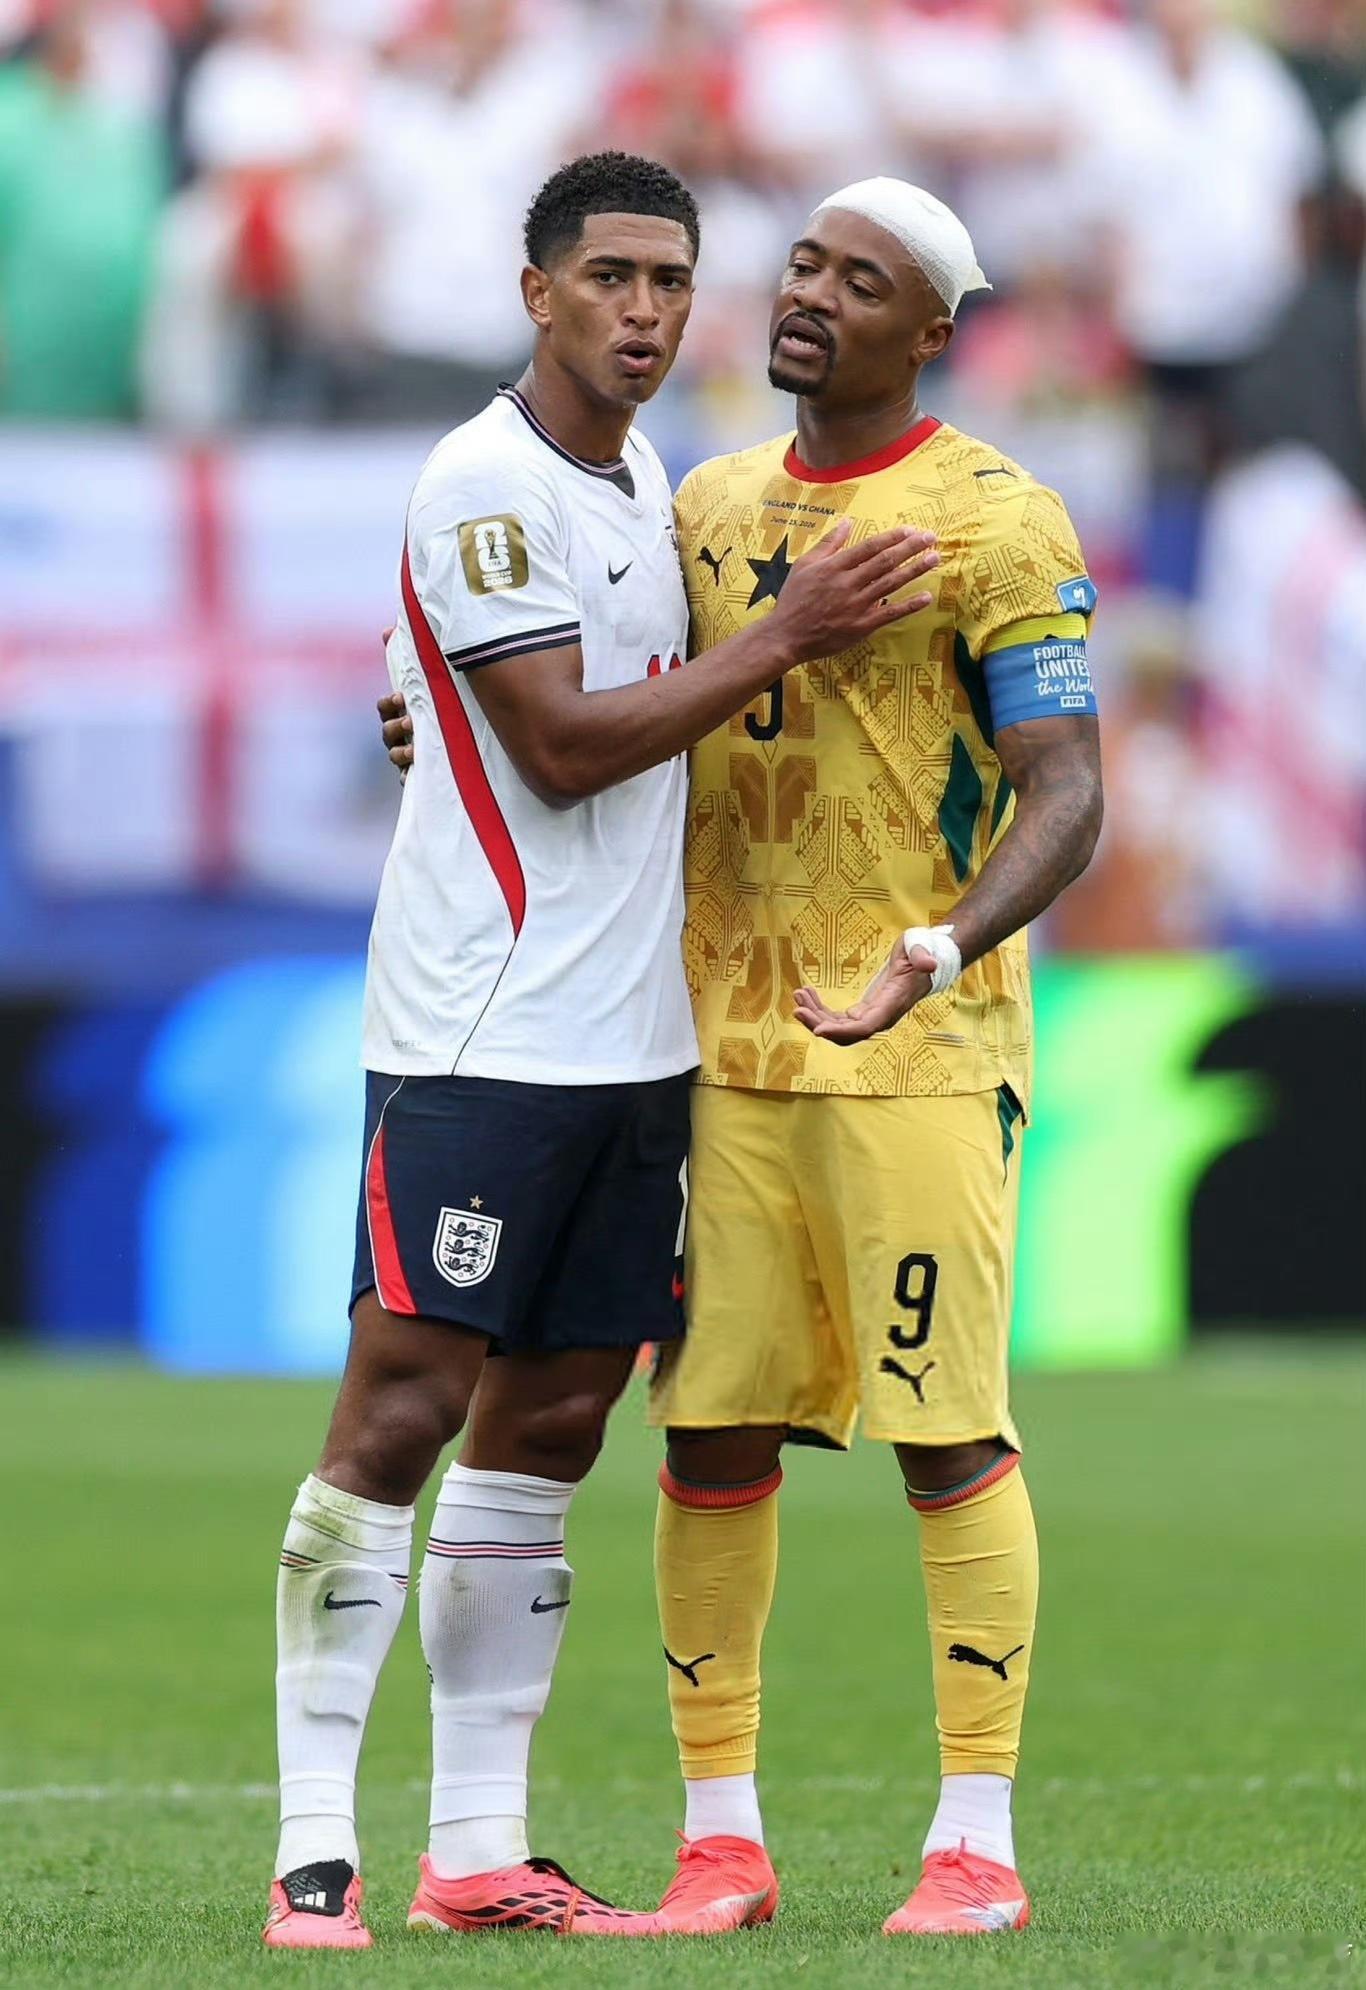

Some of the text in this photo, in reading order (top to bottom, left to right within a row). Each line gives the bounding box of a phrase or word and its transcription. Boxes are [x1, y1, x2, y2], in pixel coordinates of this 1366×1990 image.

[762, 500, 797, 510] ENGLAND
[808, 506, 835, 515] GHANA
[770, 516, 788, 525] June
[483, 576, 513, 588] 2026
[1033, 679, 1063, 696] the
[1062, 697, 1084, 706] FIFA
[888, 1253, 938, 1349] 9
